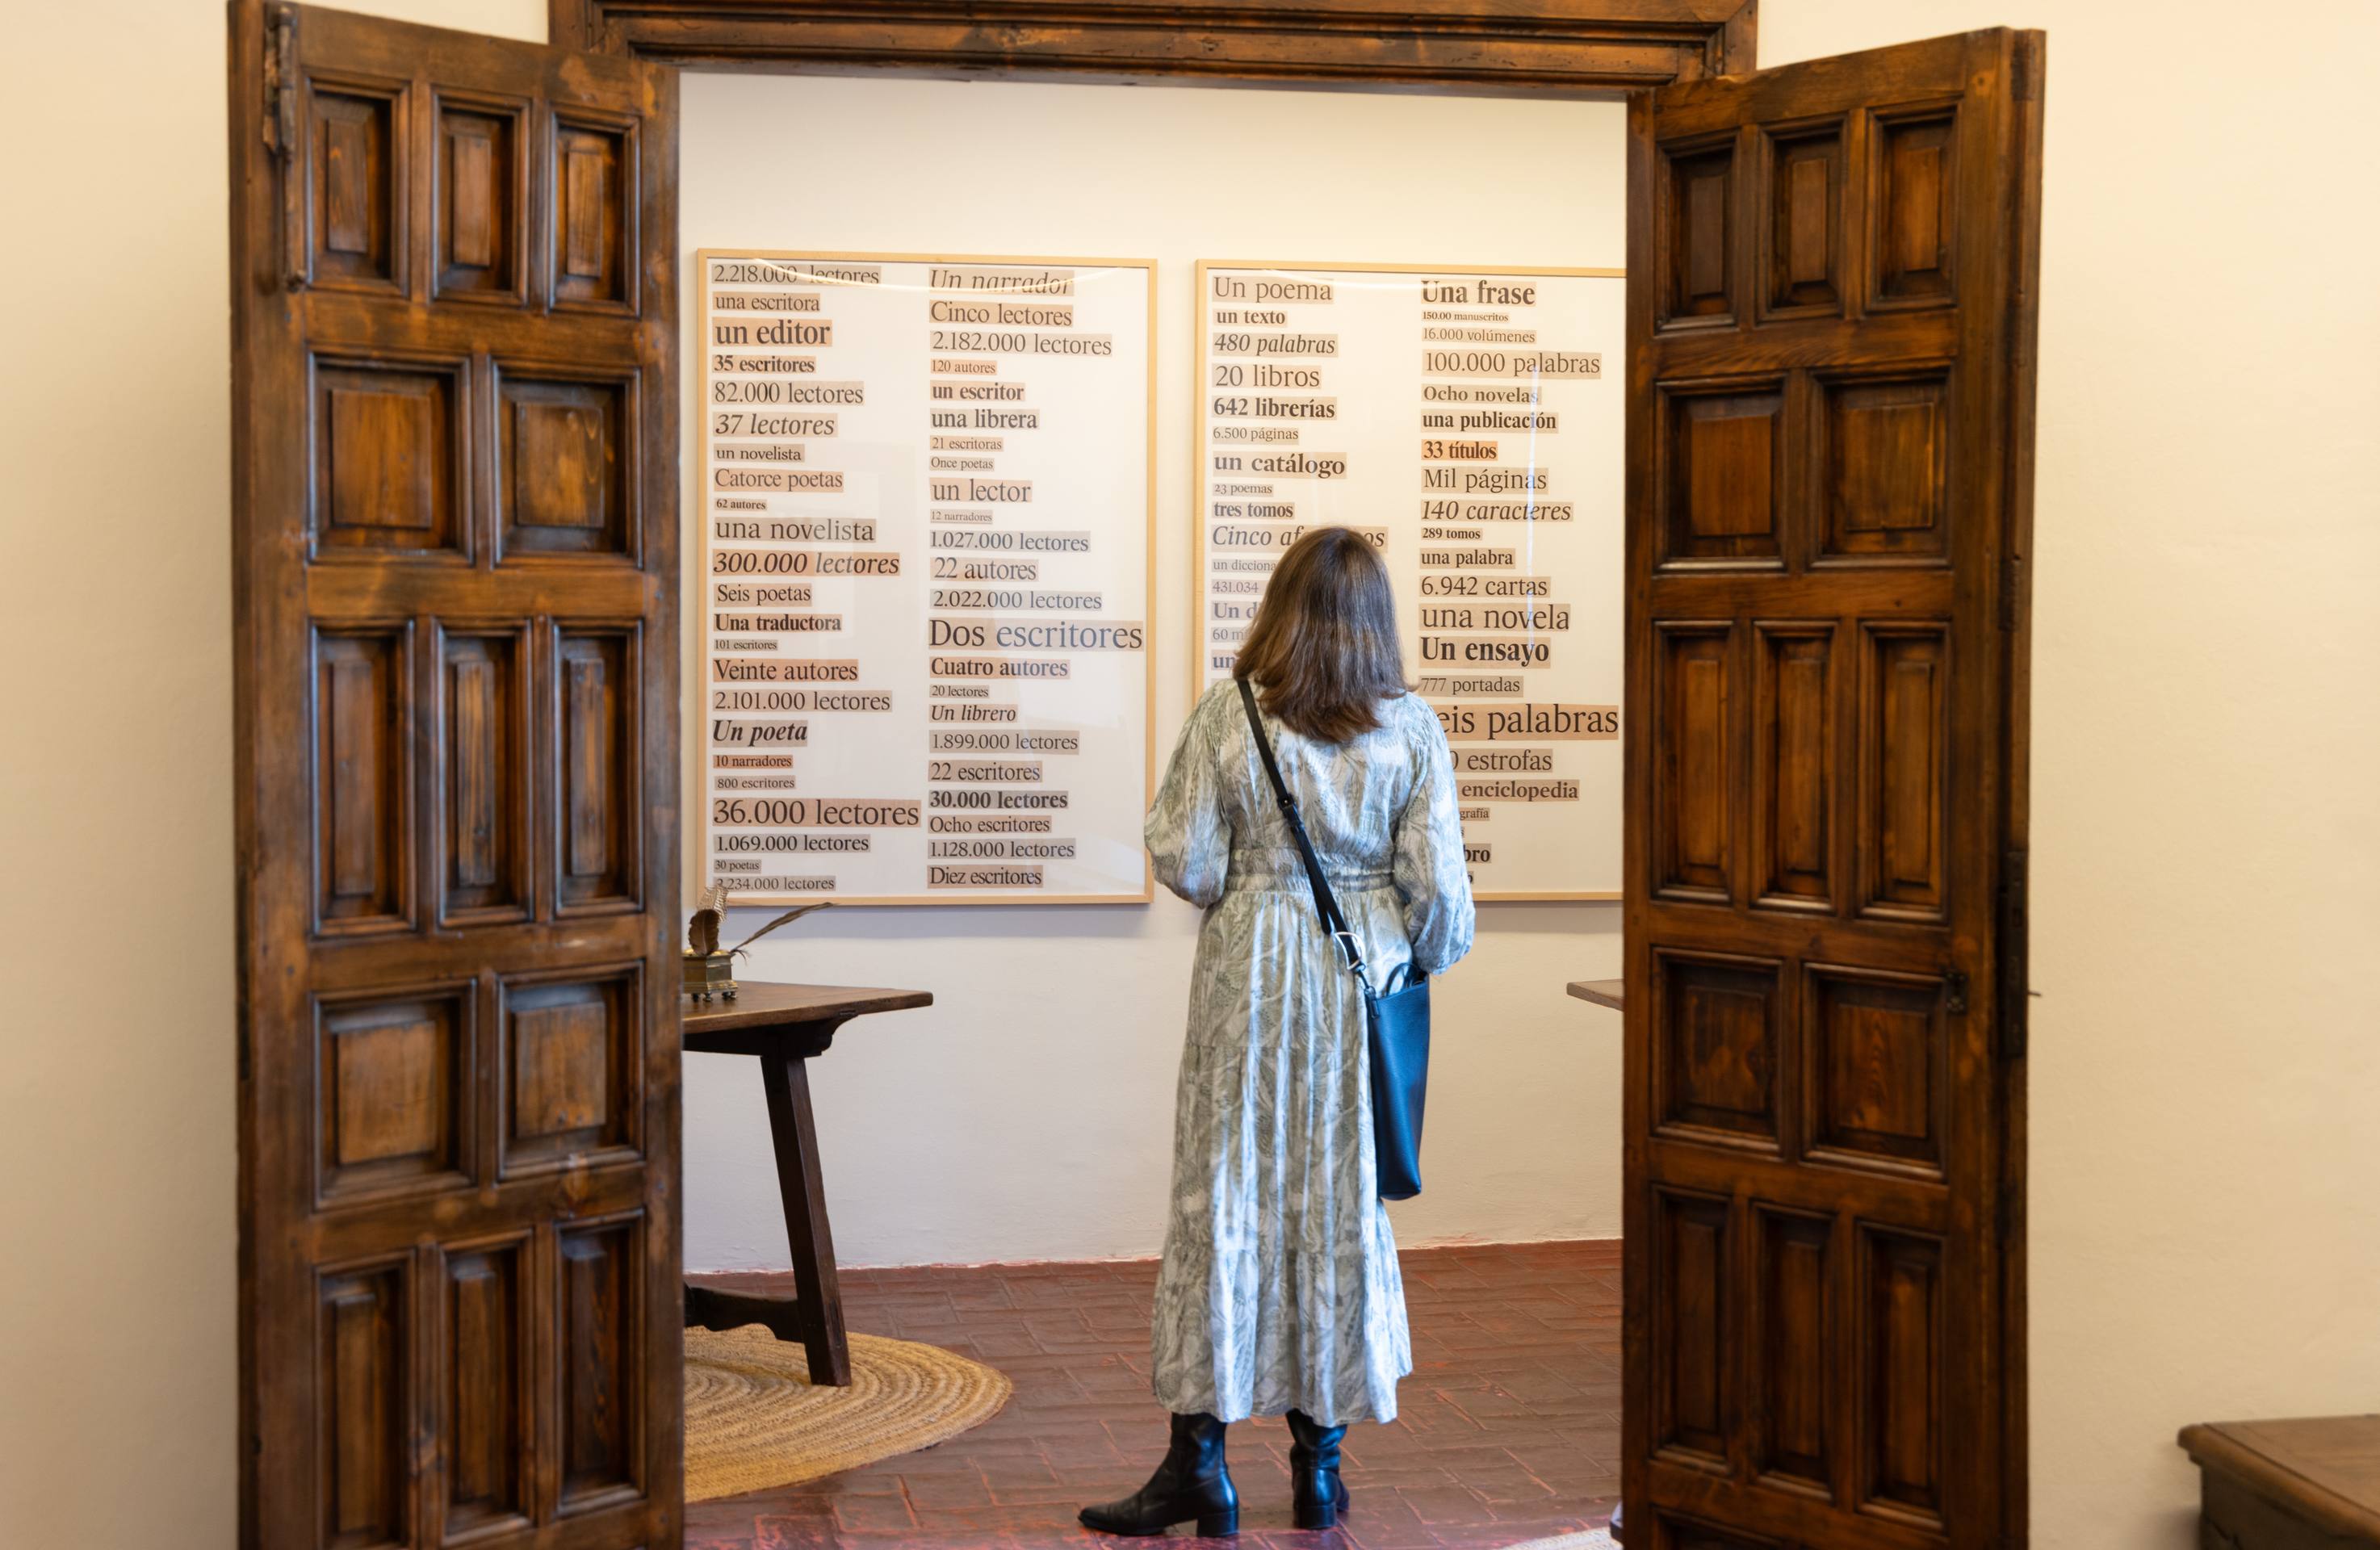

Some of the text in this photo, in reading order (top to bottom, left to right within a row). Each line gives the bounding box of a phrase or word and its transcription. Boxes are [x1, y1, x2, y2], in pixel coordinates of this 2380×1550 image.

[714, 265, 879, 285] 2.218.000 lectores
[930, 270, 1074, 295] Un narrador
[1213, 276, 1333, 304] Un poema
[1421, 279, 1536, 305] Una frase
[714, 293, 820, 312] una escritora
[930, 300, 1072, 327] Cinco lectores
[1217, 311, 1286, 325] un texto
[1422, 312, 1509, 322] 150.00 manuscritos
[715, 319, 831, 345] un editor
[1423, 328, 1536, 343] 16.000 volúmenes
[932, 331, 1112, 355] 2.182.000 lectores
[1214, 333, 1335, 356] 480 palabras
[714, 354, 815, 373] 35 escritores
[931, 359, 996, 374] 120 autores
[1427, 352, 1601, 376] 100.000 palabras
[1215, 364, 1320, 387] 20 libros
[714, 382, 864, 404] 82.000 lectores
[932, 383, 1024, 400] un escritor
[1423, 386, 1538, 404] Ocho novelas
[1213, 397, 1335, 418] 642 librerías
[715, 413, 835, 435] 37 lectores
[931, 408, 1037, 429] una librera
[1422, 411, 1557, 432] una publicación
[932, 438, 1003, 450] 21 escritoras
[1213, 427, 1299, 442] 6.500 páginas
[716, 446, 802, 461] un novelista
[1423, 441, 1497, 459] 33 títulos
[930, 456, 994, 471] Once poetas
[1214, 453, 1346, 479] un catálogo
[714, 468, 843, 492] Catorce poetas
[1424, 468, 1547, 493] Mil páginas
[932, 478, 1031, 503] un lector
[1214, 484, 1273, 496] 23 poemas
[716, 500, 766, 510] 62 autores
[1213, 502, 1293, 517] tres tomos
[1421, 501, 1572, 521] 140 caracteres
[931, 510, 992, 522] 12 narradores
[715, 518, 875, 541] una novelista
[1213, 526, 1272, 546] Cinco
[1422, 528, 1481, 539] 289 tomos
[930, 532, 1089, 551] 1.027.000 lectores
[713, 551, 900, 574] 300.000 lectores
[1213, 559, 1276, 572] un dicciona
[1421, 549, 1513, 568] una palabra
[934, 556, 1037, 581] 22 autores
[717, 584, 811, 605] Seis poetas
[1213, 580, 1259, 593] 431.034
[1421, 576, 1548, 596] 6.942 cartas
[933, 591, 1102, 610] 2.022.000 lectores
[1213, 602, 1240, 618] Un
[714, 614, 841, 631] Una traductora
[1422, 604, 1569, 630] una novela
[929, 619, 1142, 649] Dos escritores
[1213, 628, 1228, 640] 60
[714, 639, 777, 650] 101 escritores
[1421, 636, 1549, 668] Un ensayo
[713, 659, 858, 681] Veinte autores
[931, 657, 1068, 677] Cuatro autores
[932, 685, 989, 698] 20 lectores
[1421, 677, 1520, 695] 777 portadas
[714, 691, 890, 710] 2.101.000 lectores
[930, 705, 1016, 722] Un librero
[1436, 703, 1619, 740] eis palabras
[713, 719, 808, 747] Un poeta
[932, 734, 1079, 751] 1.899.000 lectores
[715, 756, 792, 767] 10 narradores
[1467, 749, 1552, 771] estrofas
[930, 762, 1040, 781] 22 escritores
[717, 777, 795, 789] 800 escritores
[1461, 779, 1578, 802] enciclopedia
[930, 790, 1069, 809] 30.000 lectores
[714, 799, 920, 826] 36.000 lectores
[1459, 809, 1490, 820] grafía
[929, 815, 1050, 832] Ocho escritores
[716, 835, 869, 852] 1.069.000 lectores
[930, 840, 1075, 857] 1.128.000 lectores
[1463, 844, 1490, 862] bro
[714, 860, 760, 872] 30 poetas
[930, 866, 1042, 885] Diez escritores
[784, 878, 835, 890] lectores
